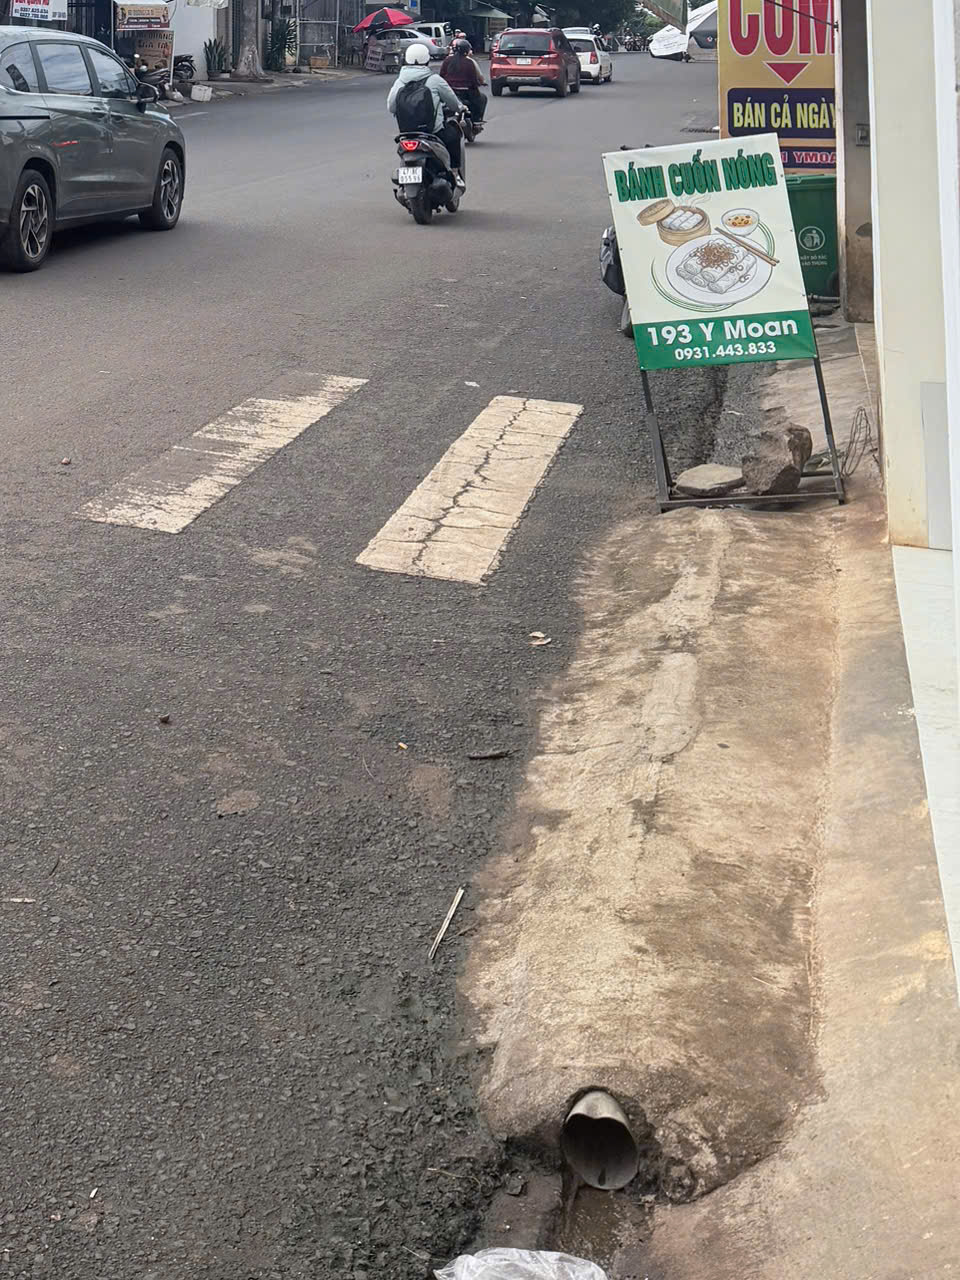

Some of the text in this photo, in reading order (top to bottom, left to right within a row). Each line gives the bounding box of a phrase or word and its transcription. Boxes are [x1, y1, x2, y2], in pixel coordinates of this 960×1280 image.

[733, 97, 766, 128] BÁN
[770, 94, 792, 128] CẢ
[614, 149, 778, 202] BÁNH CUỐN NÓNG
[647, 319, 799, 346] 193 Y Moan
[674, 341, 777, 361] 0931.443.833
